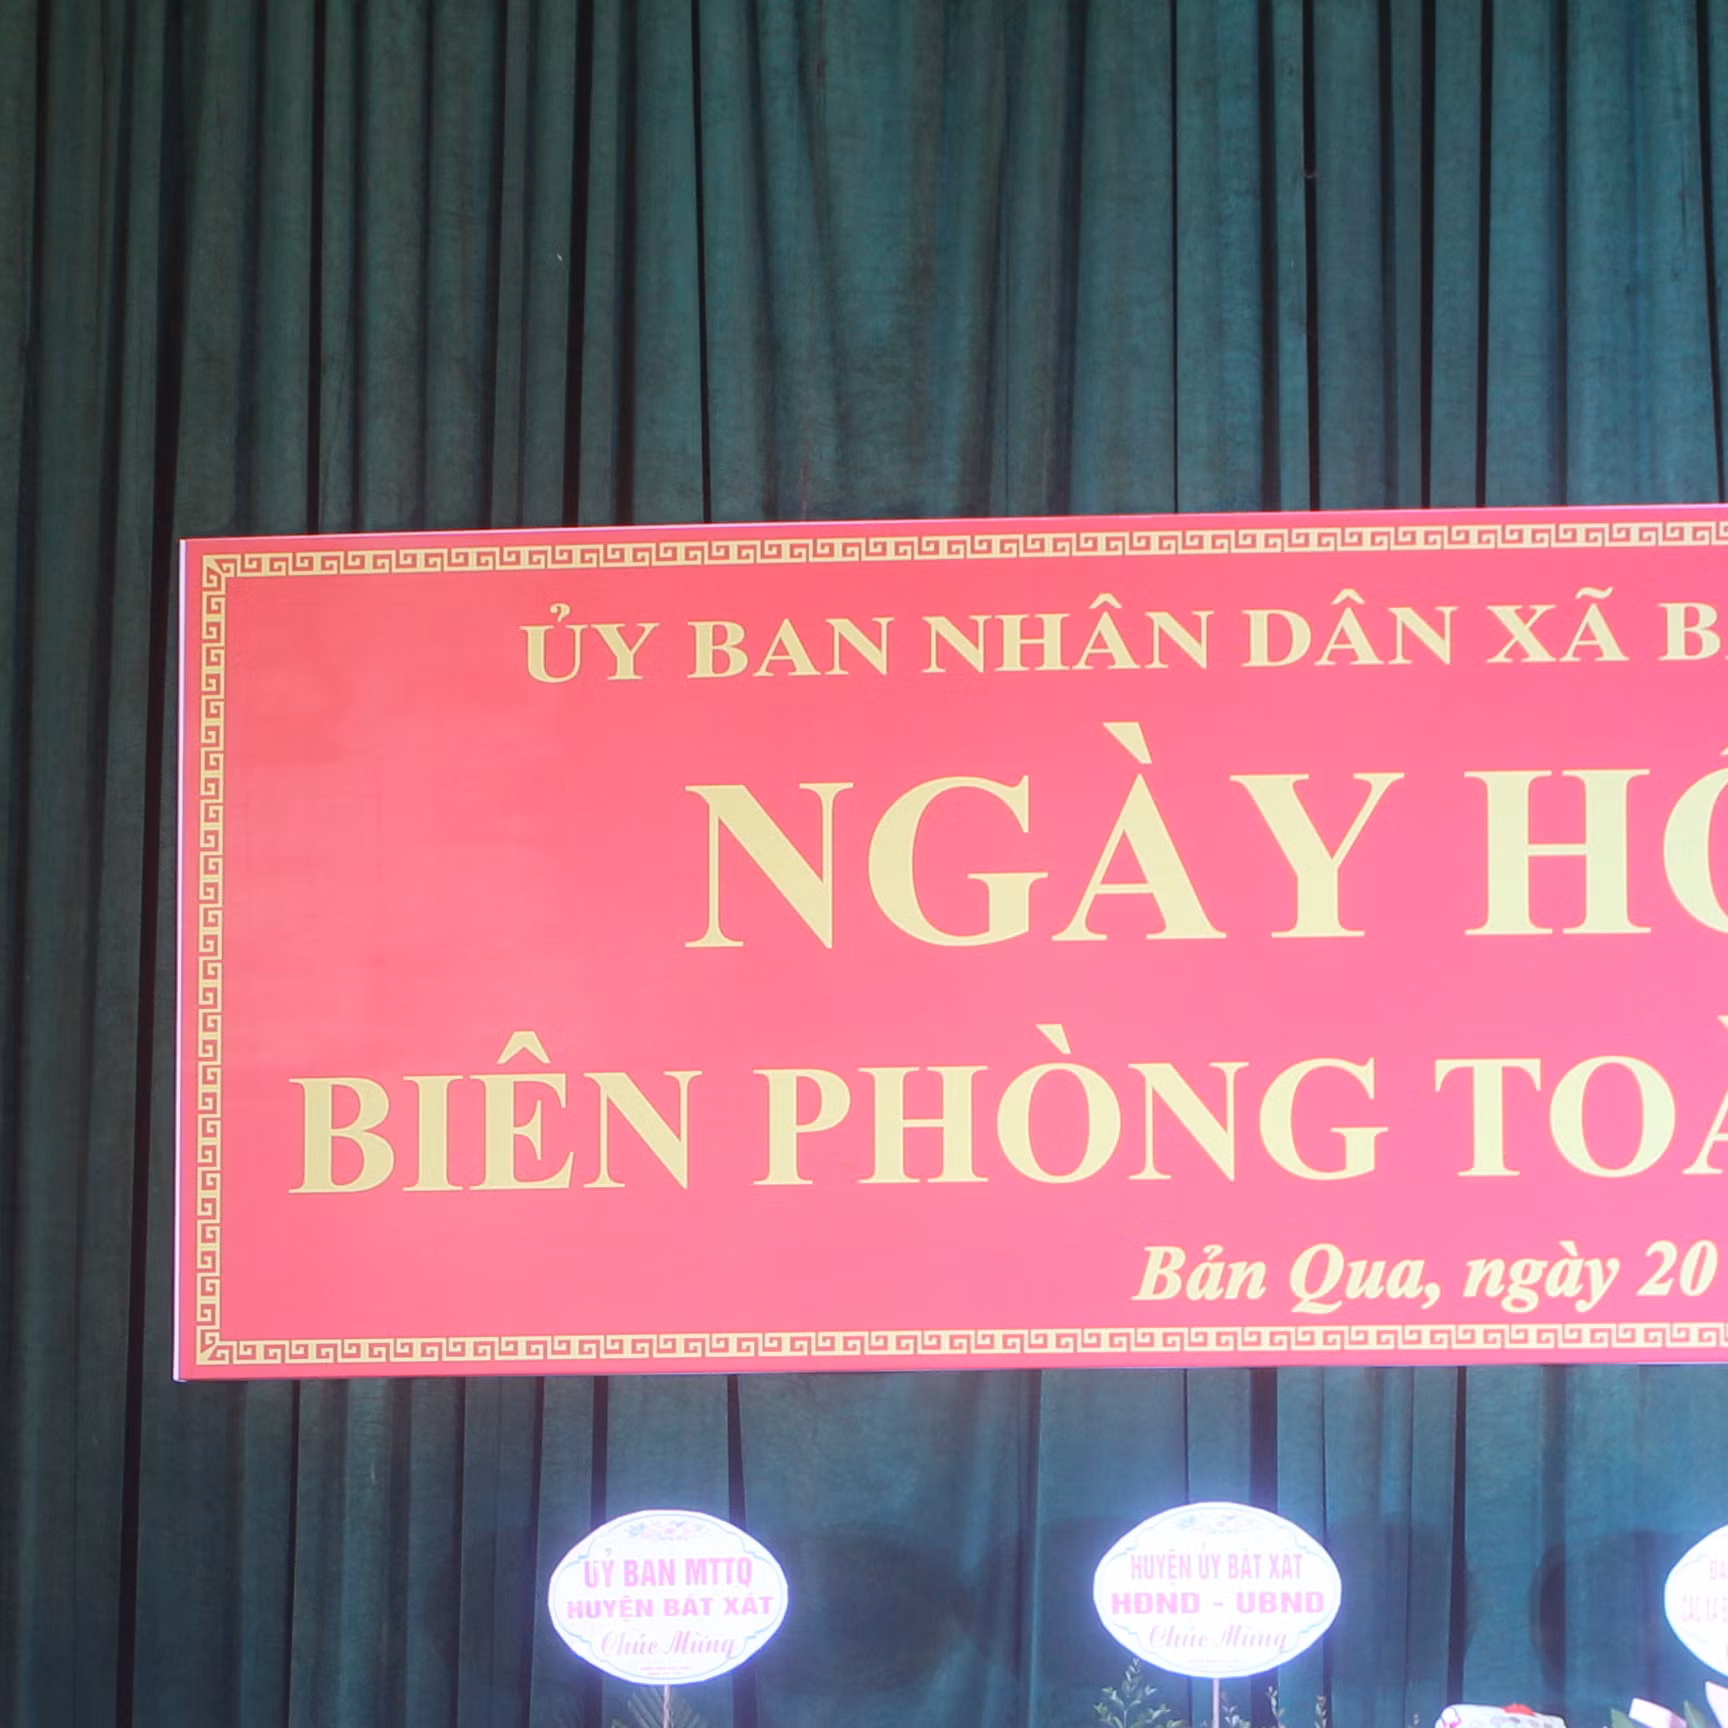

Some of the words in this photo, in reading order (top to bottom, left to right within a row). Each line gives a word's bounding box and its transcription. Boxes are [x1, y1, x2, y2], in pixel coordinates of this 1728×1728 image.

[518, 602, 660, 684] ỦY
[687, 616, 894, 679] BAN
[922, 592, 1214, 673] NHÂN
[1243, 588, 1457, 667] DÂN
[1487, 586, 1630, 664] XÃ
[685, 721, 1406, 949] NGÀY
[288, 1030, 704, 1194] BIÊN
[752, 1023, 1388, 1187] PHÒNG
[1131, 1244, 1267, 1301] Bản
[1289, 1243, 1442, 1314] Qua,
[1463, 1240, 1621, 1313] ngày
[1636, 1239, 1718, 1297] 20
[623, 1558, 676, 1587] BAN
[685, 1556, 753, 1588] MTTQ
[567, 1595, 655, 1623] HUYỆN
[1235, 1591, 1326, 1615] UBND
[600, 1631, 660, 1656] Chúc
